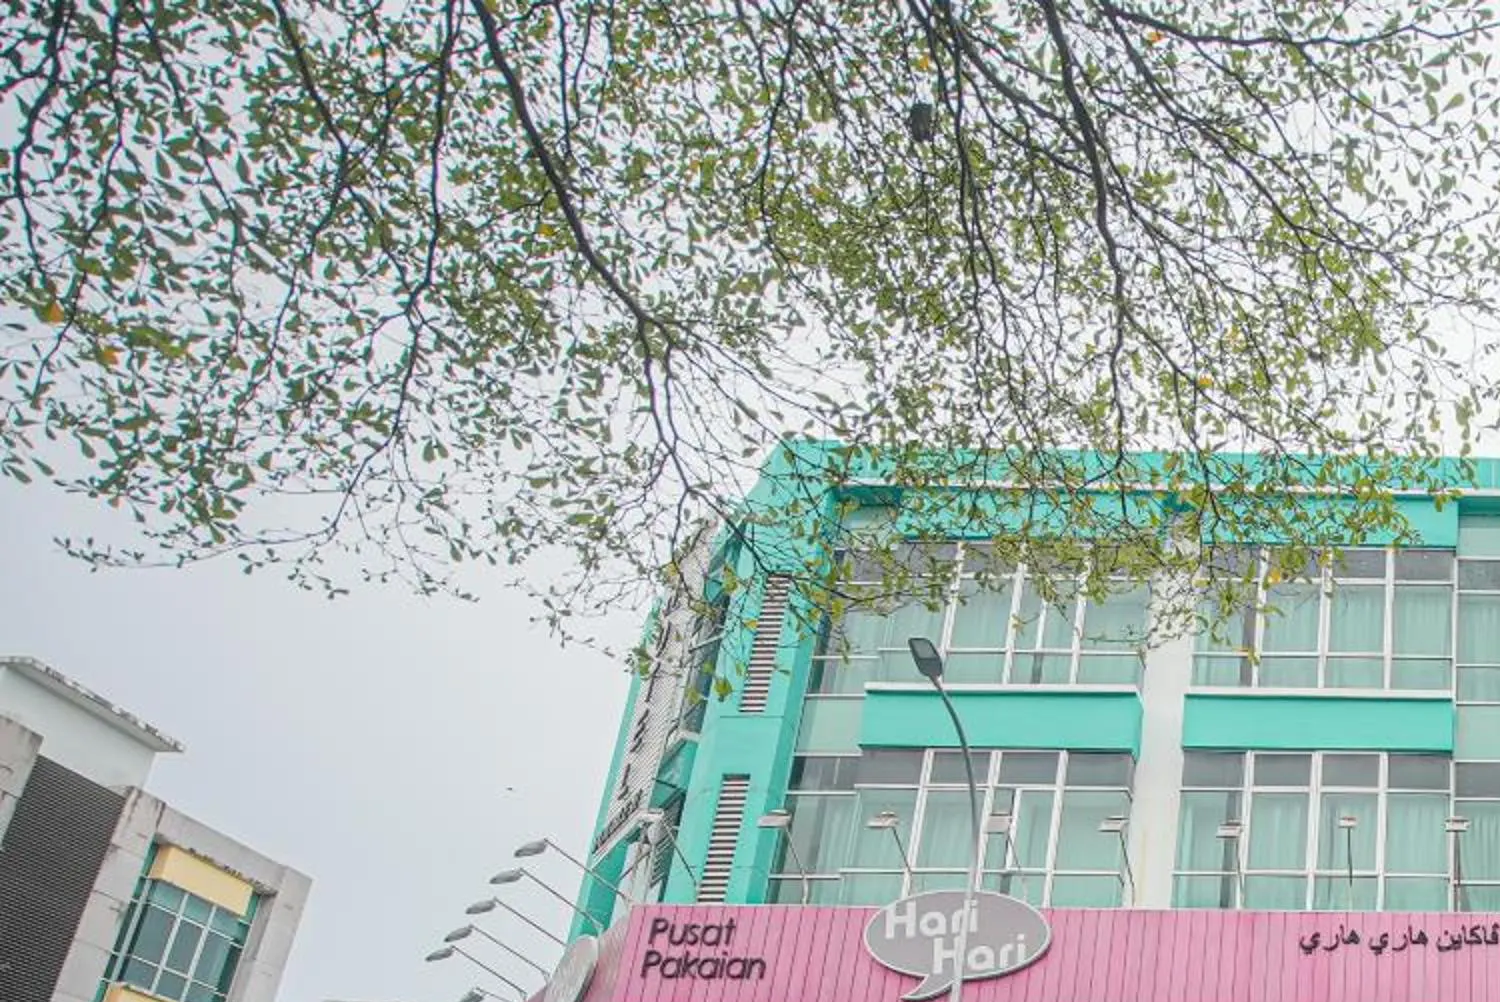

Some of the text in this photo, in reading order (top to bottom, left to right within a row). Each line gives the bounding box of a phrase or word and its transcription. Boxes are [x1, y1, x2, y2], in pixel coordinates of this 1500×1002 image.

[648, 917, 736, 948] Pusat
[885, 899, 979, 939] Hari
[640, 950, 767, 981] Pakaian
[931, 933, 1027, 975] Hari
